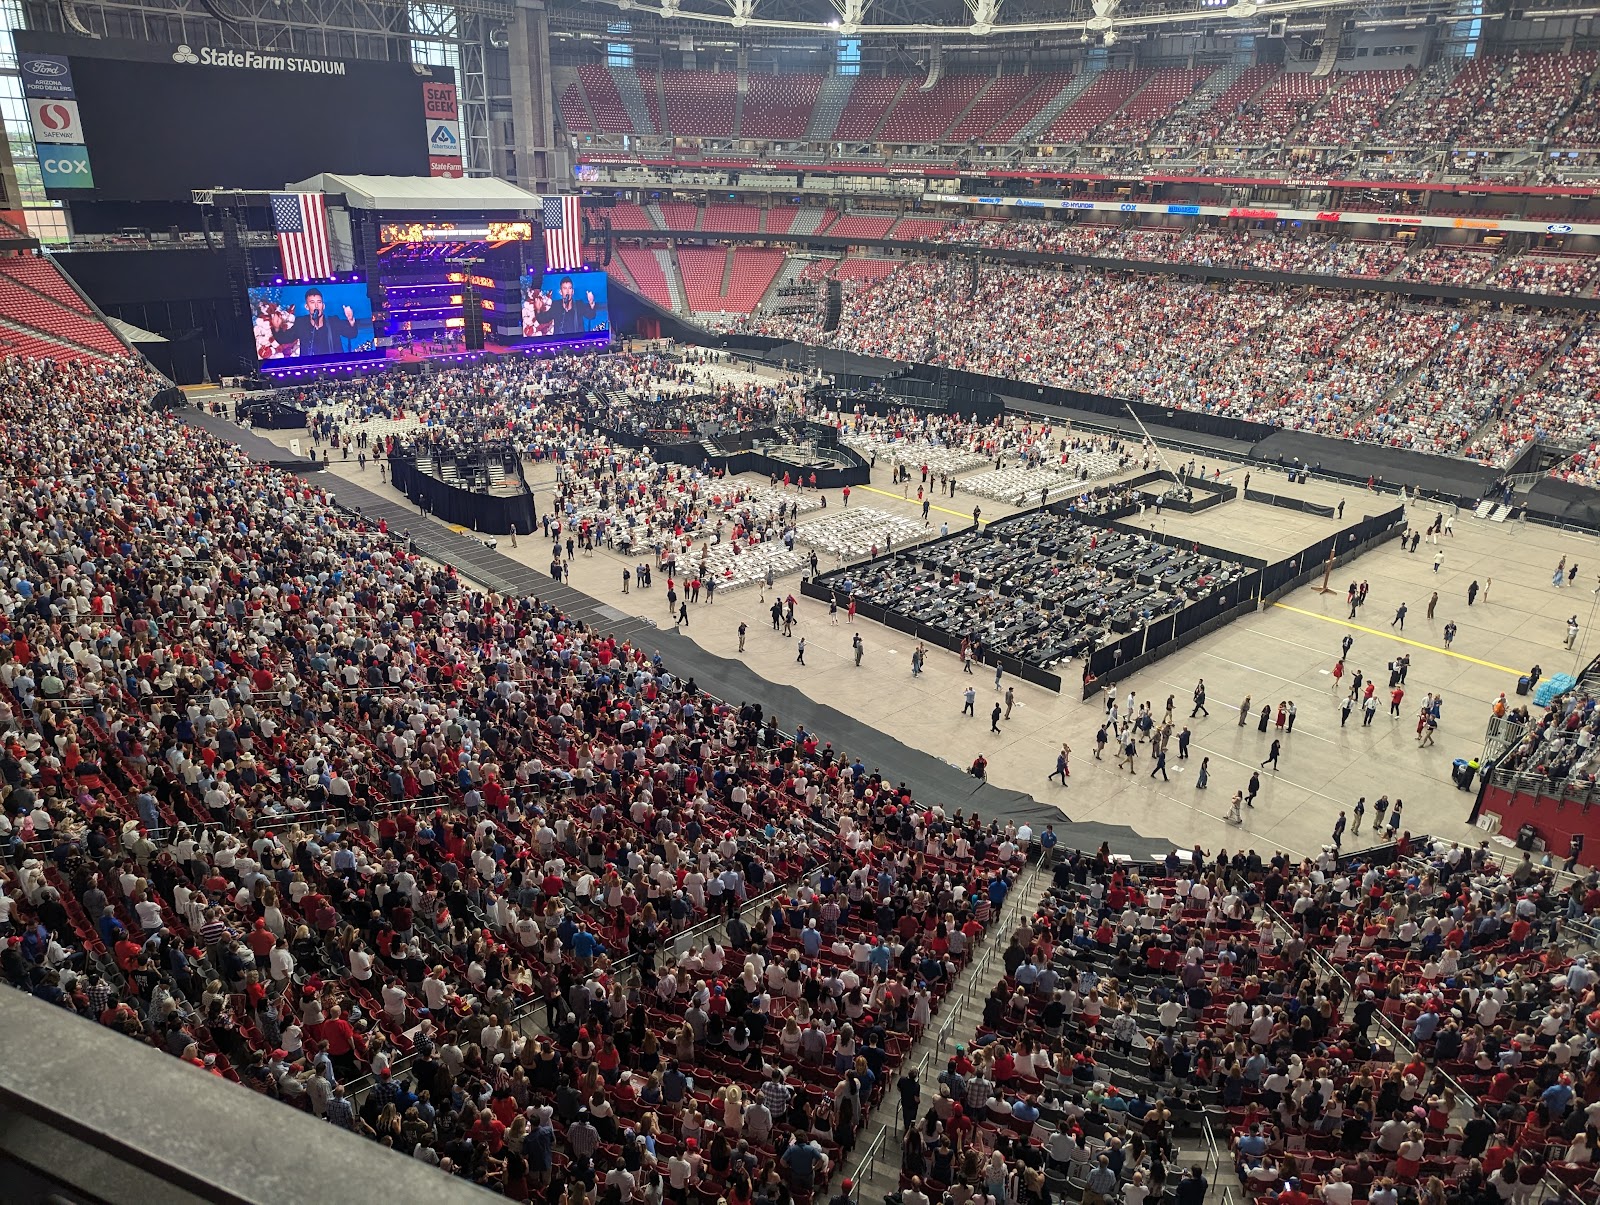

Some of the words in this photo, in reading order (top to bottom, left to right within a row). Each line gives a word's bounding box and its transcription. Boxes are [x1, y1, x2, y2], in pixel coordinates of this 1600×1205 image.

[32, 62, 59, 75] Ford
[287, 58, 346, 75] STADIUM
[427, 88, 452, 101] SEAT
[427, 101, 454, 113] GEEK
[44, 131, 73, 139] SAFEWAY
[44, 159, 88, 174] COX
